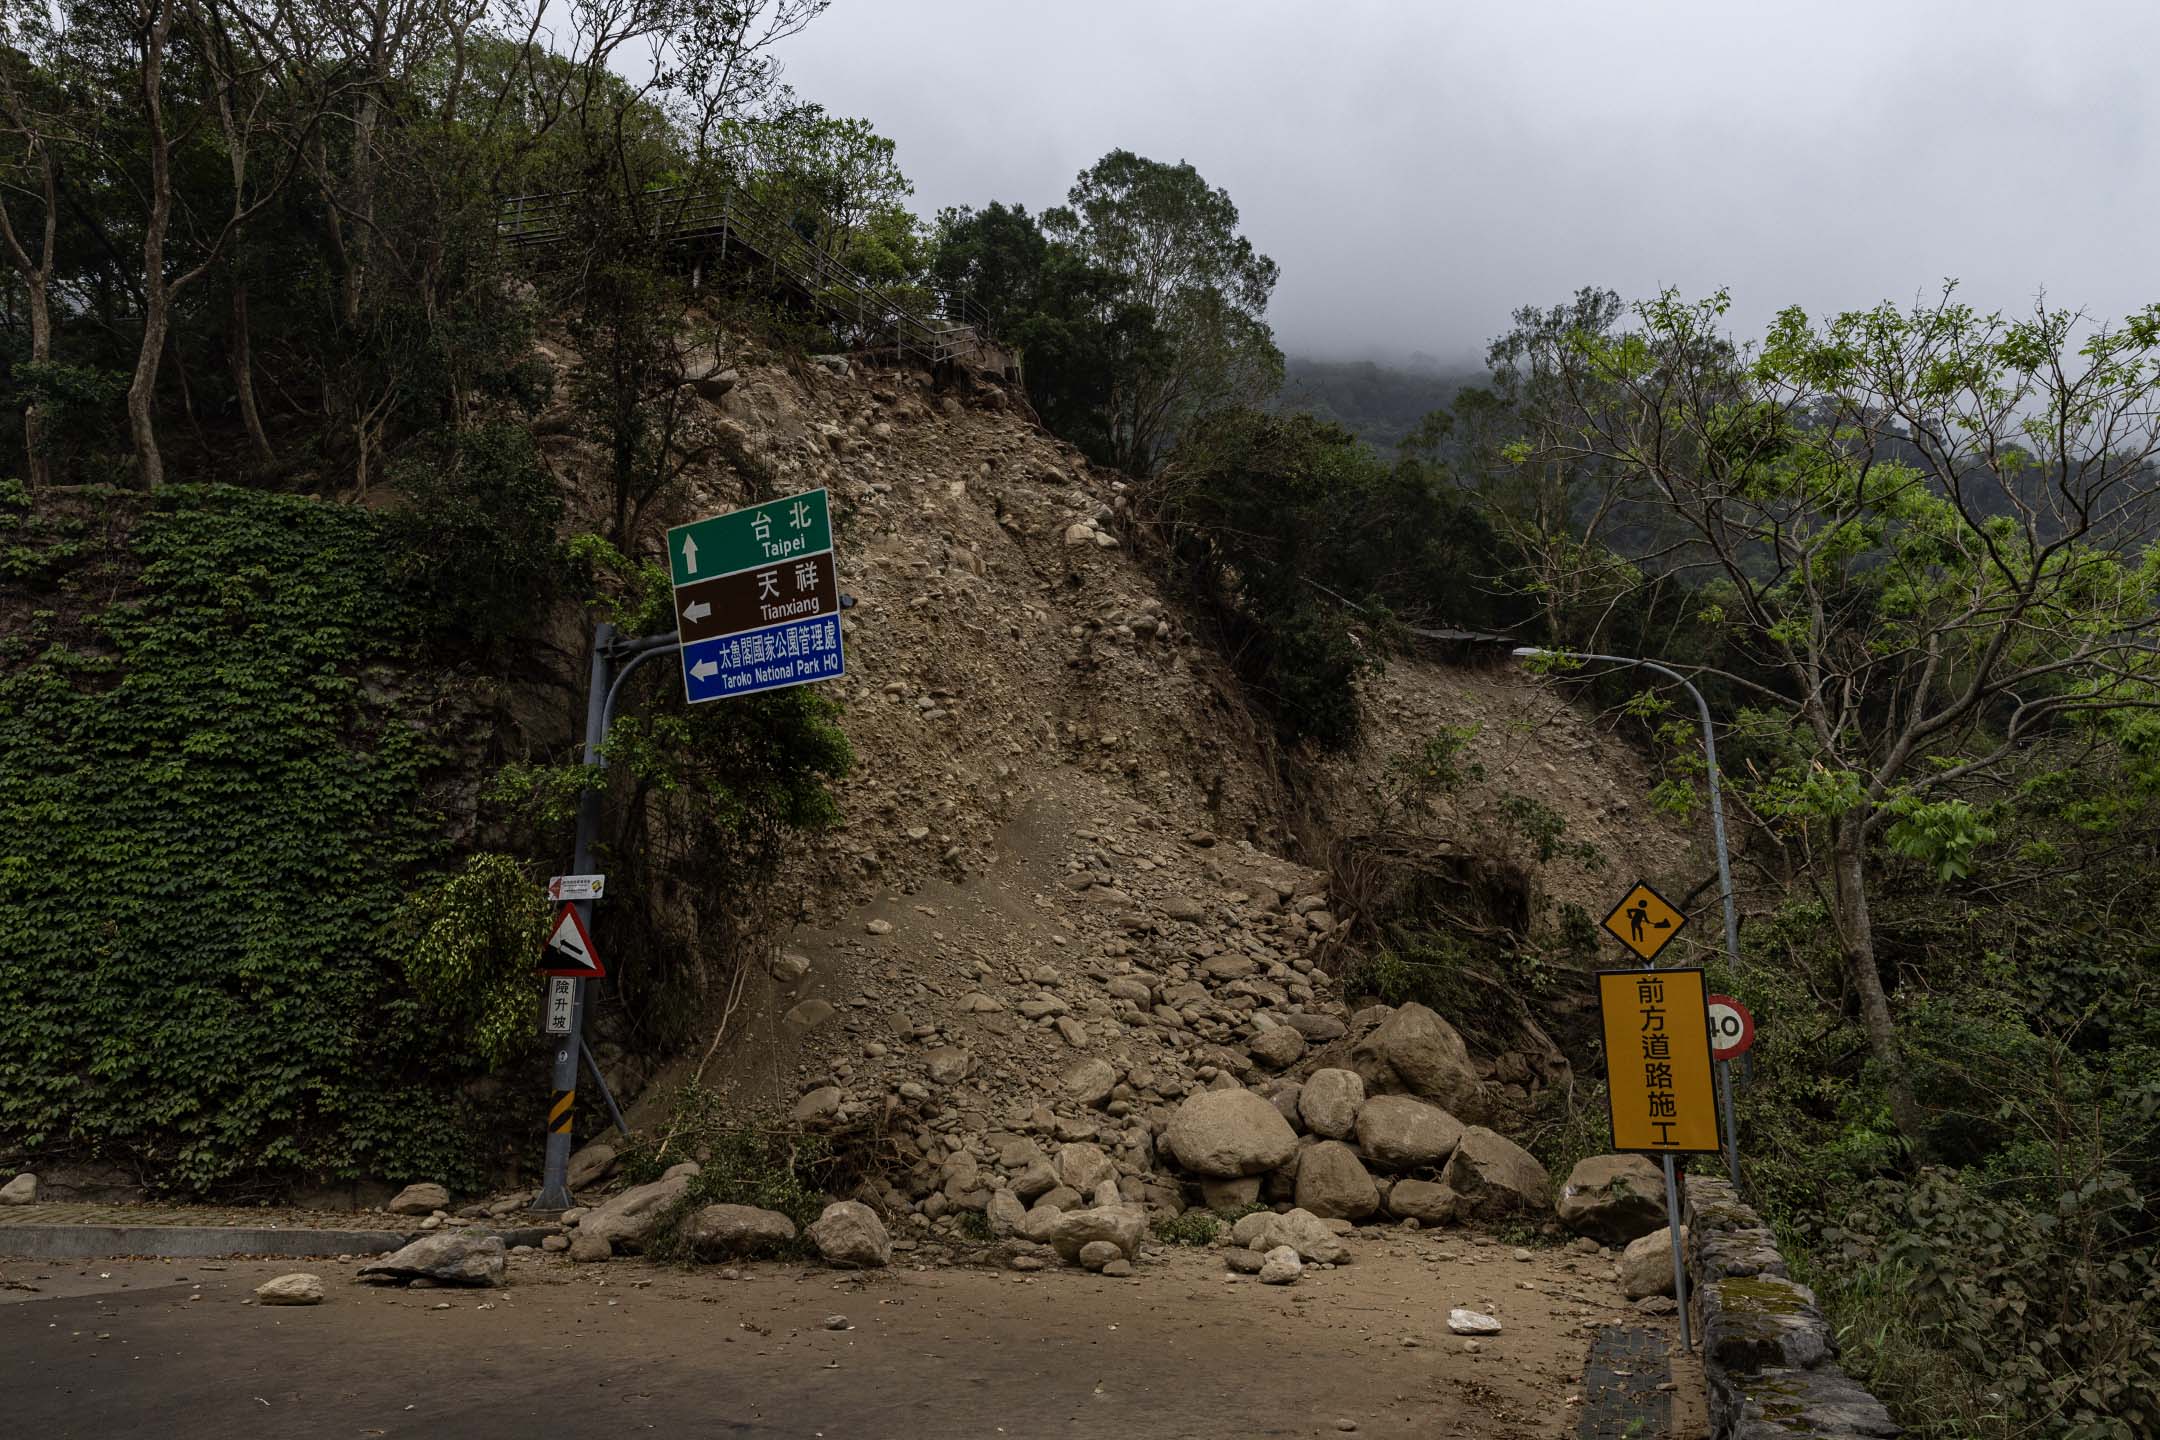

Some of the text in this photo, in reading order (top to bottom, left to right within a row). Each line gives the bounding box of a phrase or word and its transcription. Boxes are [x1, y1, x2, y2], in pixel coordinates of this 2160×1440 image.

[751, 501, 812, 541] 台北
[762, 534, 806, 558] Taipei
[757, 561, 819, 601] 天祥
[760, 596, 820, 621] Tianxiang
[719, 621, 836, 669] 太魯閣國家公園管理處
[722, 655, 838, 689] Taroko National Park HQ
[552, 980, 570, 1029] 險升坡
[1636, 978, 1680, 1146] 前方道路施工
